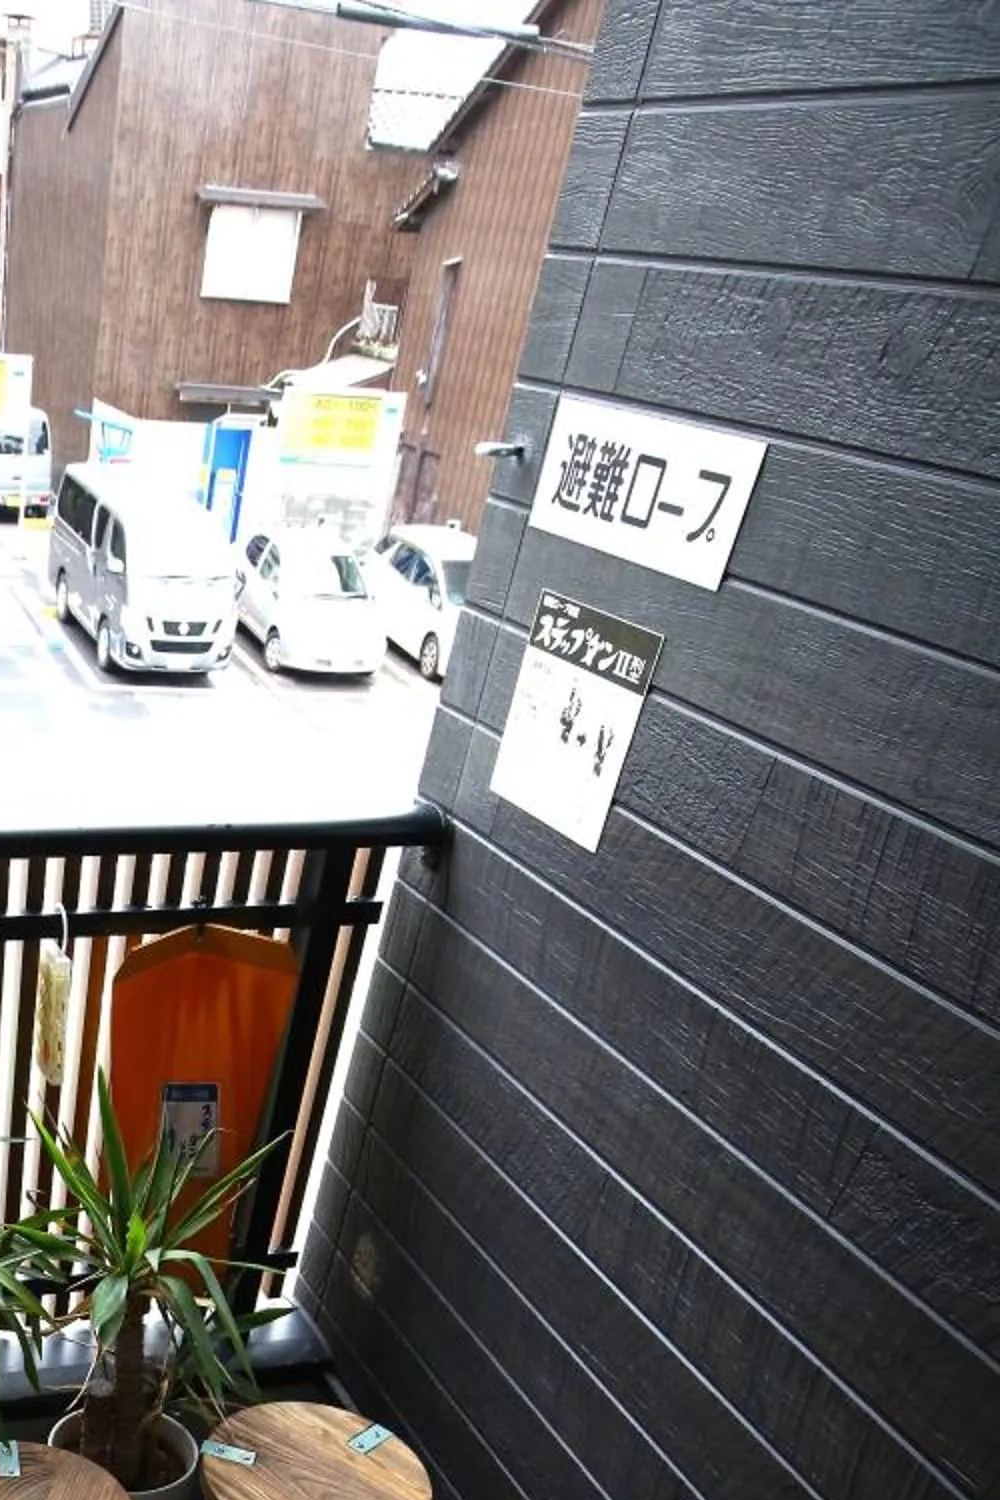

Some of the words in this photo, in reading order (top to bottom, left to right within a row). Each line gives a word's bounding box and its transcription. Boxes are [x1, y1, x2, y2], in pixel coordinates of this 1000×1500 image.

[553, 434, 732, 543] 避難ロープ
